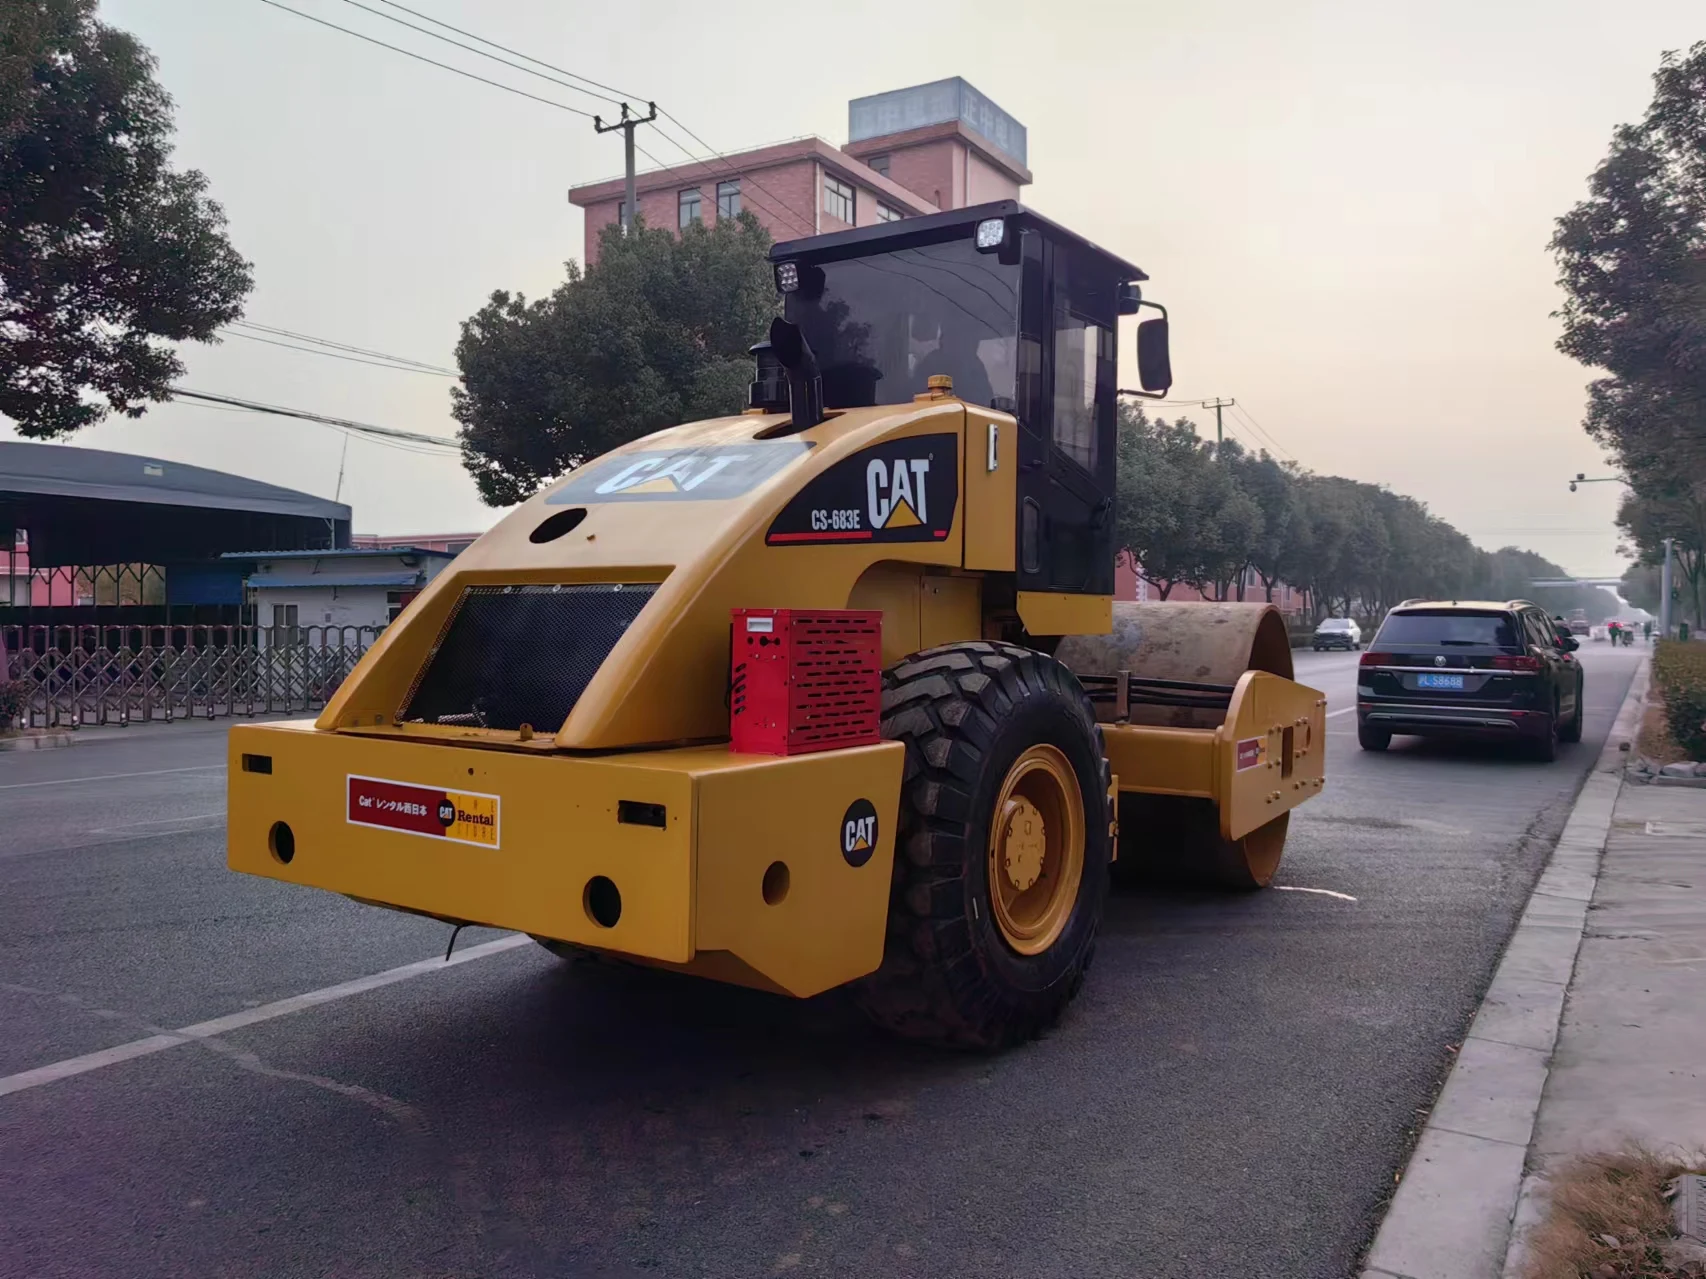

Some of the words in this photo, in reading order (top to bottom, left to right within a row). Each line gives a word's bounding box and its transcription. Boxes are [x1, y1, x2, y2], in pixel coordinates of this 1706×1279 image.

[594, 454, 752, 495] CAT
[866, 458, 931, 530] CAT
[811, 509, 861, 530] CS-683E
[376, 798, 428, 816] レンタル西日本
[439, 806, 453, 820] CAT
[457, 809, 494, 826] Rental
[845, 816, 876, 852] CAT
